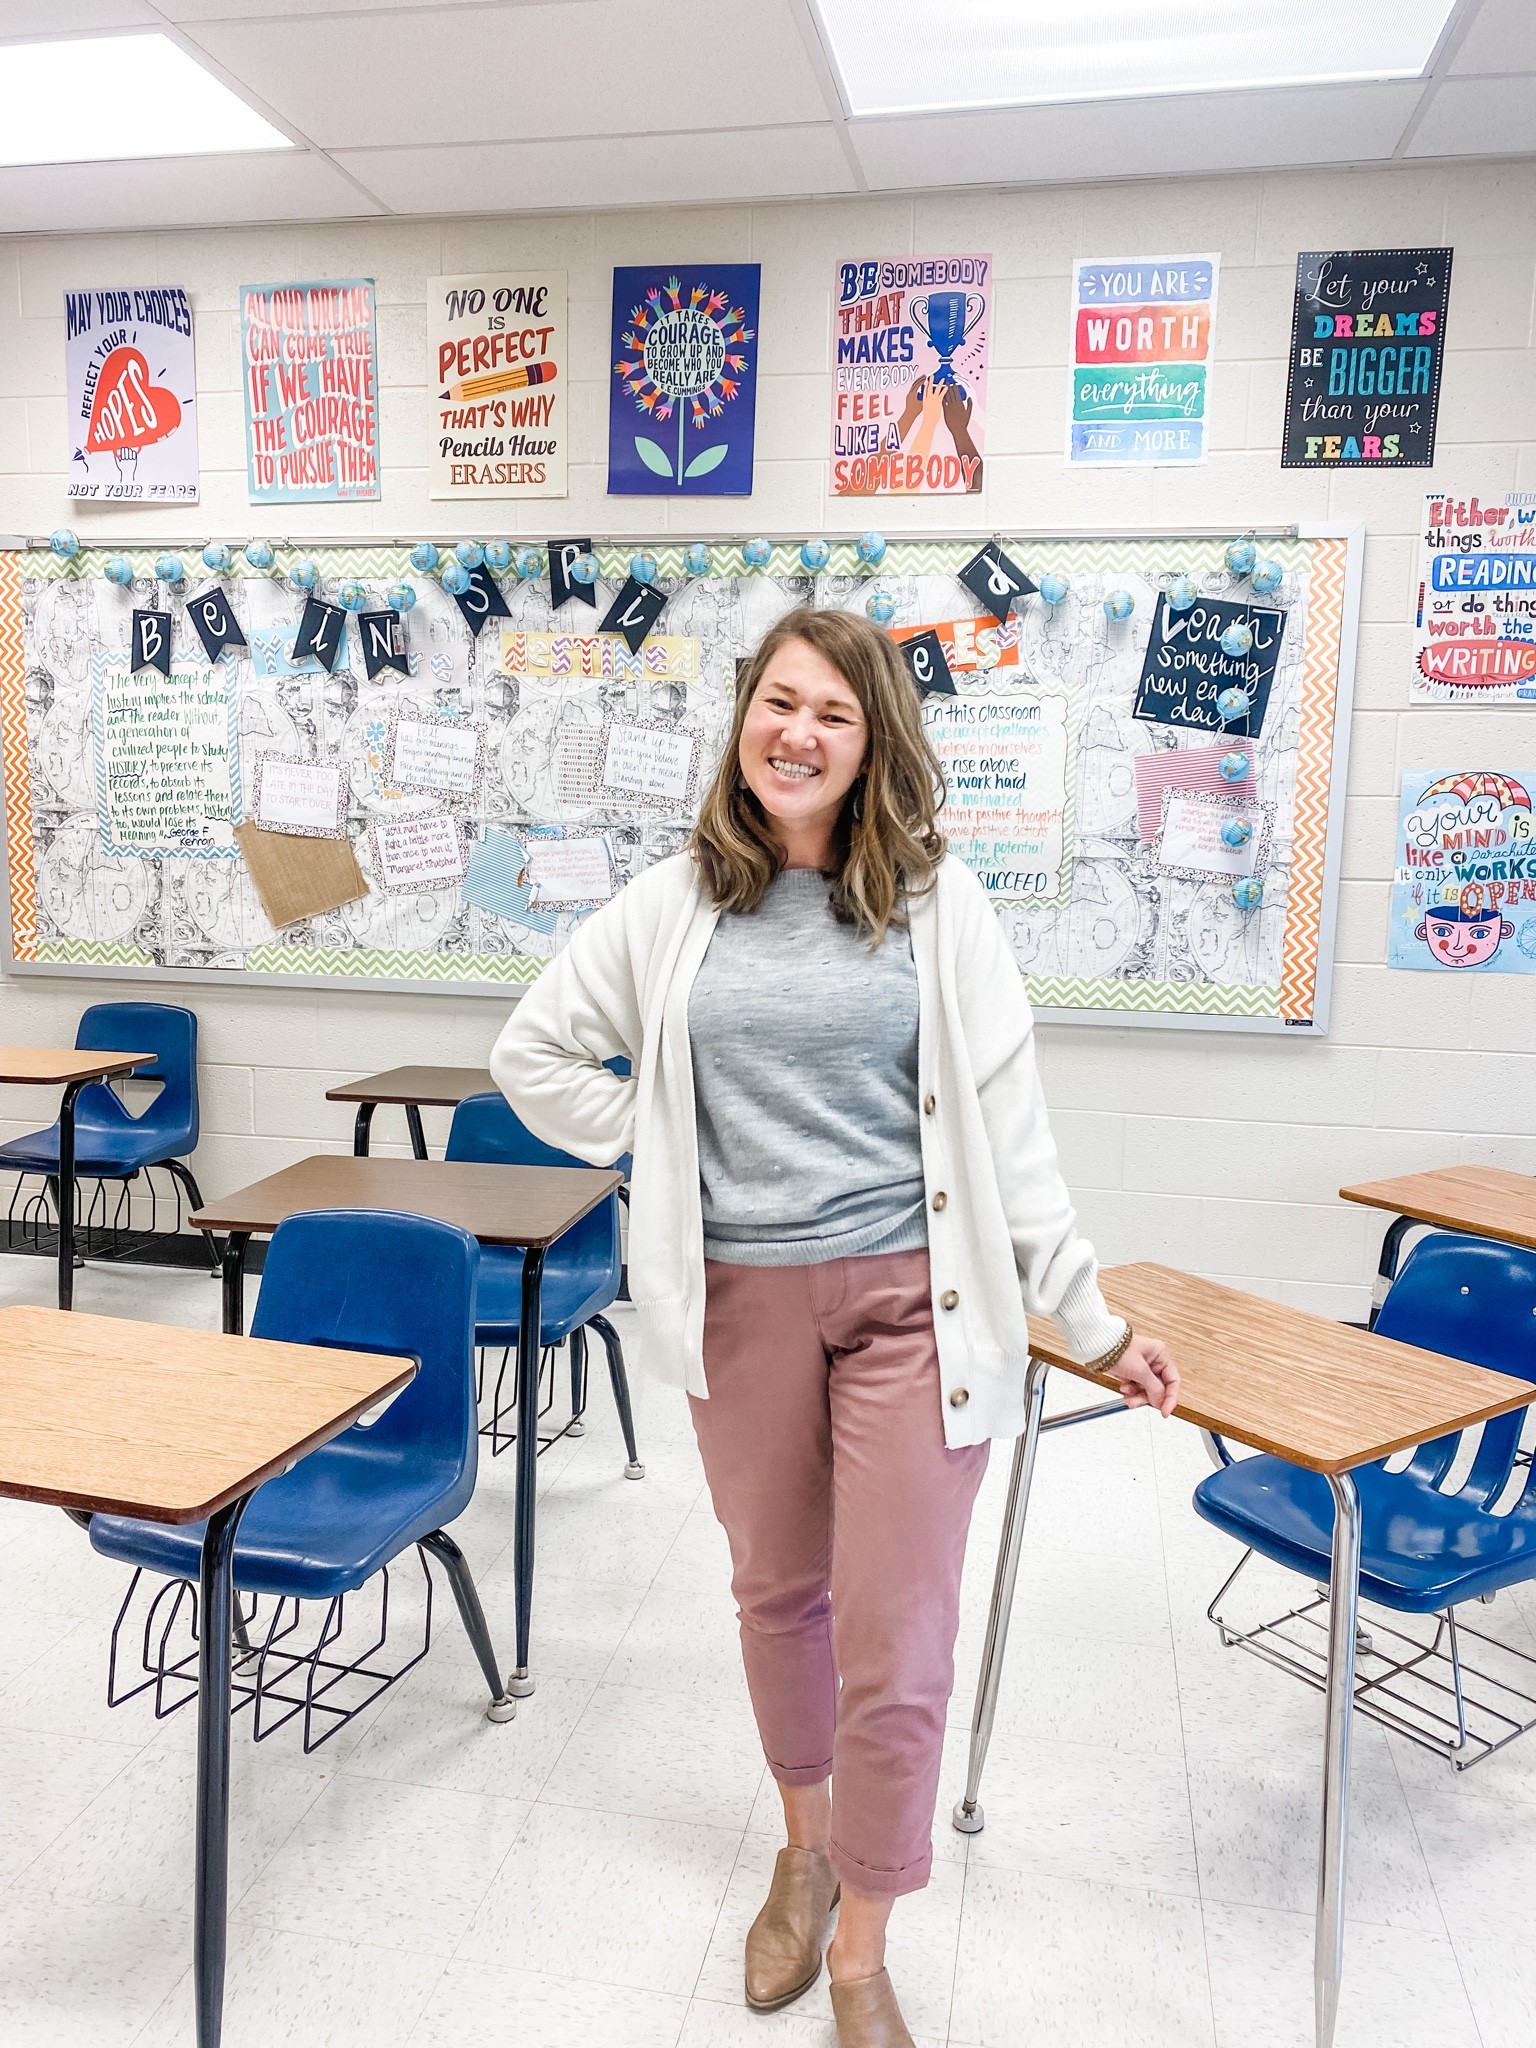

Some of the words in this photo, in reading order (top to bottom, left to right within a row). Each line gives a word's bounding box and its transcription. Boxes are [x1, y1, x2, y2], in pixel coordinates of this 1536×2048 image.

[840, 262, 880, 305] BE
[881, 259, 988, 287] SOMEBODY
[1100, 272, 1142, 297] YOU
[1151, 270, 1189, 296] ARE
[1304, 260, 1353, 308] Let
[1362, 279, 1417, 310] your
[245, 292, 271, 327] ALL
[271, 289, 305, 333] OUR
[307, 287, 370, 333] DREAMS
[445, 289, 485, 321] NO
[493, 287, 548, 317] ONE
[839, 291, 905, 334] THAT
[66, 292, 92, 340] MAY
[96, 292, 133, 326] YOUR
[133, 290, 192, 337] CHOICES
[487, 316, 505, 330] IS
[676, 310, 710, 324] TAKES
[1313, 311, 1437, 338] DREAMS
[247, 323, 280, 363] CAN
[284, 334, 327, 361] COME
[332, 330, 372, 357] TRUE
[649, 323, 720, 346] COURAGE
[1087, 316, 1199, 351] WORTH
[439, 327, 555, 383] PERFECT
[646, 347, 657, 358] TO
[660, 344, 686, 358] GROW
[690, 345, 702, 357] UP
[706, 345, 723, 358] AND
[837, 326, 914, 364] MAKES
[81, 361, 101, 419] REFLECT
[94, 329, 127, 358] YOUR
[648, 358, 680, 371] BECOME
[684, 358, 701, 371] WHO
[706, 359, 721, 369] YOU
[1300, 348, 1324, 367] BE
[1328, 347, 1431, 396] BIGGER
[249, 365, 269, 415] IF
[276, 363, 311, 409] WE
[319, 357, 375, 402] HAVE
[653, 370, 691, 386] REALLY
[695, 370, 715, 385] ARE
[837, 365, 919, 392] EVERYBODY
[93, 359, 158, 444] HOPES
[1081, 368, 1201, 416] everything
[440, 400, 506, 429] THAT'S
[511, 394, 555, 427] WHY
[837, 394, 893, 422] FEEL
[1300, 395, 1354, 421] than
[1364, 403, 1419, 433] your
[250, 416, 287, 453] THE
[292, 397, 375, 447] COURAGE
[439, 436, 504, 457] Pencils
[508, 435, 557, 456] Have
[834, 424, 879, 456] LIKE
[887, 422, 900, 450] A
[1086, 434, 1122, 448] AND
[1133, 430, 1191, 450] MORE
[1304, 434, 1404, 459] FEARS.
[252, 454, 274, 487] TO
[278, 440, 334, 487] PURSUE
[336, 440, 377, 486] THEM
[450, 463, 546, 485] ERASERS
[834, 453, 980, 491] SOMEBODY
[68, 485, 100, 497] NOT
[104, 485, 143, 498] YOUR
[147, 485, 196, 498] FEARS
[1429, 497, 1514, 530] Either,
[1425, 528, 1482, 553] things
[1489, 528, 1536, 546] worth
[1433, 600, 1455, 609] or
[1462, 594, 1485, 612] do
[1428, 615, 1496, 636] worth
[1503, 618, 1533, 634] the
[164, 671, 198, 689] concept
[1145, 674, 1187, 696] new
[1197, 681, 1257, 705] ea
[179, 691, 194, 704] the
[198, 691, 228, 705] scholar
[107, 711, 126, 725] and
[148, 709, 180, 722] reader
[945, 704, 975, 724] this
[979, 705, 1041, 722] classroom
[1171, 697, 1251, 733] day
[119, 725, 177, 745] generation
[618, 726, 647, 745] Stand
[991, 723, 1049, 741] challenges
[113, 742, 153, 757] civilized
[156, 744, 187, 759] people
[637, 751, 652, 764] you
[655, 751, 679, 765] believe
[161, 760, 198, 774] preserve
[201, 760, 213, 772] its
[316, 771, 333, 781] TOO
[623, 764, 639, 772] even
[953, 759, 975, 772] rise
[980, 758, 1019, 773] above
[109, 777, 148, 790] records,
[161, 776, 191, 787] absorb
[957, 775, 991, 789] work
[995, 773, 1026, 789] hard
[115, 791, 151, 803] lessons
[155, 790, 173, 802] and
[177, 791, 203, 801] relate
[279, 796, 307, 808] START
[309, 800, 332, 812] OVER
[963, 793, 1021, 807] motivated
[136, 806, 157, 815] own
[942, 808, 974, 822] think
[976, 809, 1011, 825] positive
[1016, 808, 1063, 823] thoughts
[132, 818, 160, 828] would
[165, 817, 183, 827] lose
[420, 822, 438, 830] have
[972, 825, 1008, 841] positive
[1013, 826, 1048, 837] actions
[409, 835, 429, 845] battle
[431, 832, 450, 841] more
[970, 840, 987, 853] the
[994, 841, 1043, 858] potential
[1442, 828, 1507, 850] MIND
[403, 850, 419, 858] once
[1405, 843, 1444, 867] like
[1451, 851, 1467, 865] a
[1468, 837, 1536, 865] parachute
[387, 861, 425, 873] Margaret
[1400, 869, 1411, 881] It
[1415, 867, 1453, 886] only
[1454, 858, 1536, 882] WORKS
[978, 871, 1047, 892] SUCCEED
[1427, 889, 1440, 904] it
[1460, 879, 1536, 918] OPEN
